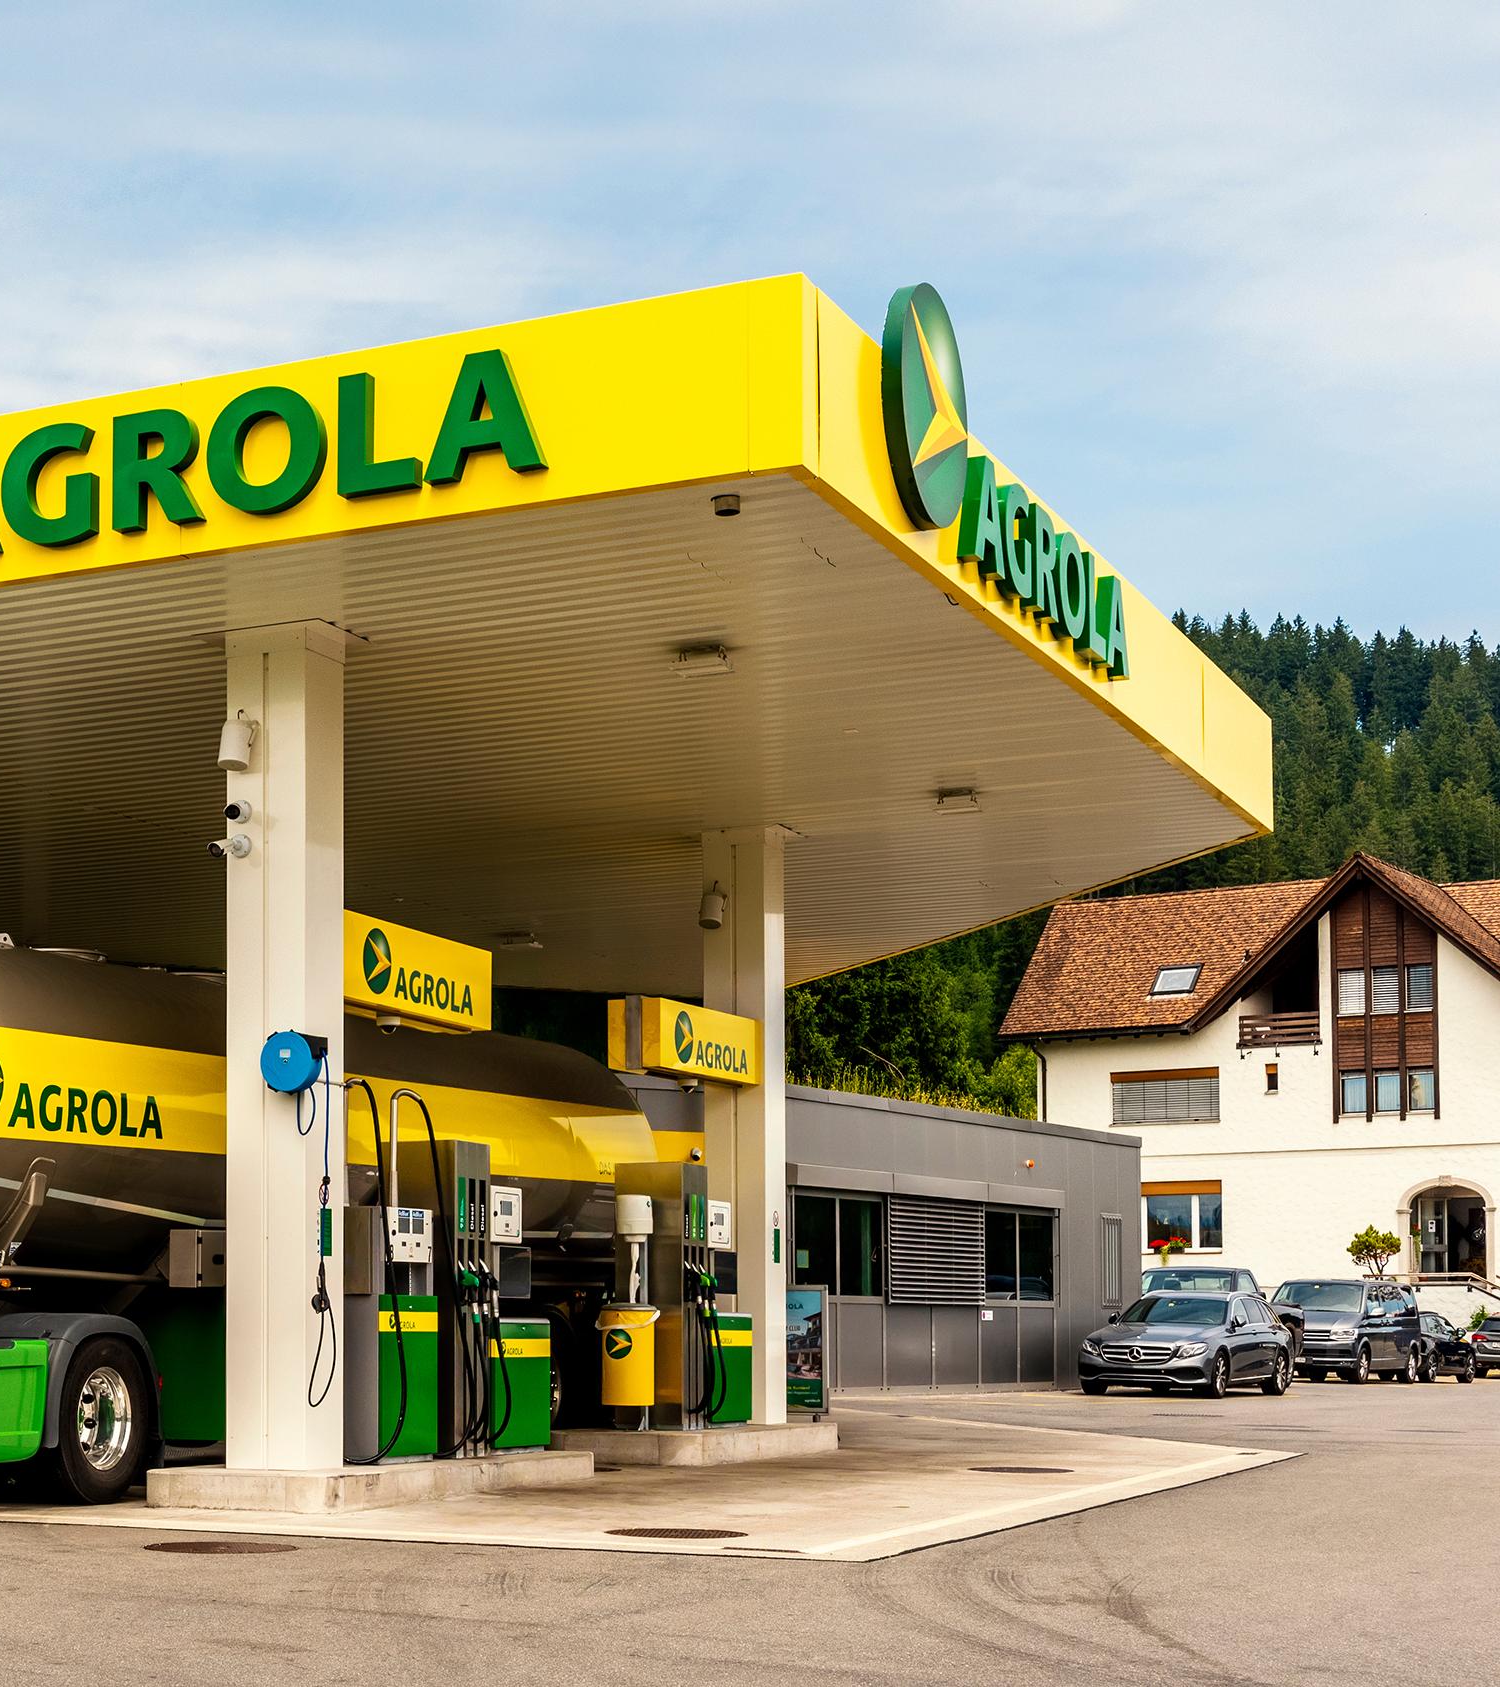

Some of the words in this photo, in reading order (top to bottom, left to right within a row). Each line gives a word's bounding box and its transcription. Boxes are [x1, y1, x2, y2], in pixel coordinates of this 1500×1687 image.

[956, 455, 1130, 681] AGROLA
[394, 966, 474, 1017] AGROLA
[695, 1039, 748, 1075] AGROLA
[7, 1082, 163, 1140] AGROLA
[427, 1246, 432, 1262] 7
